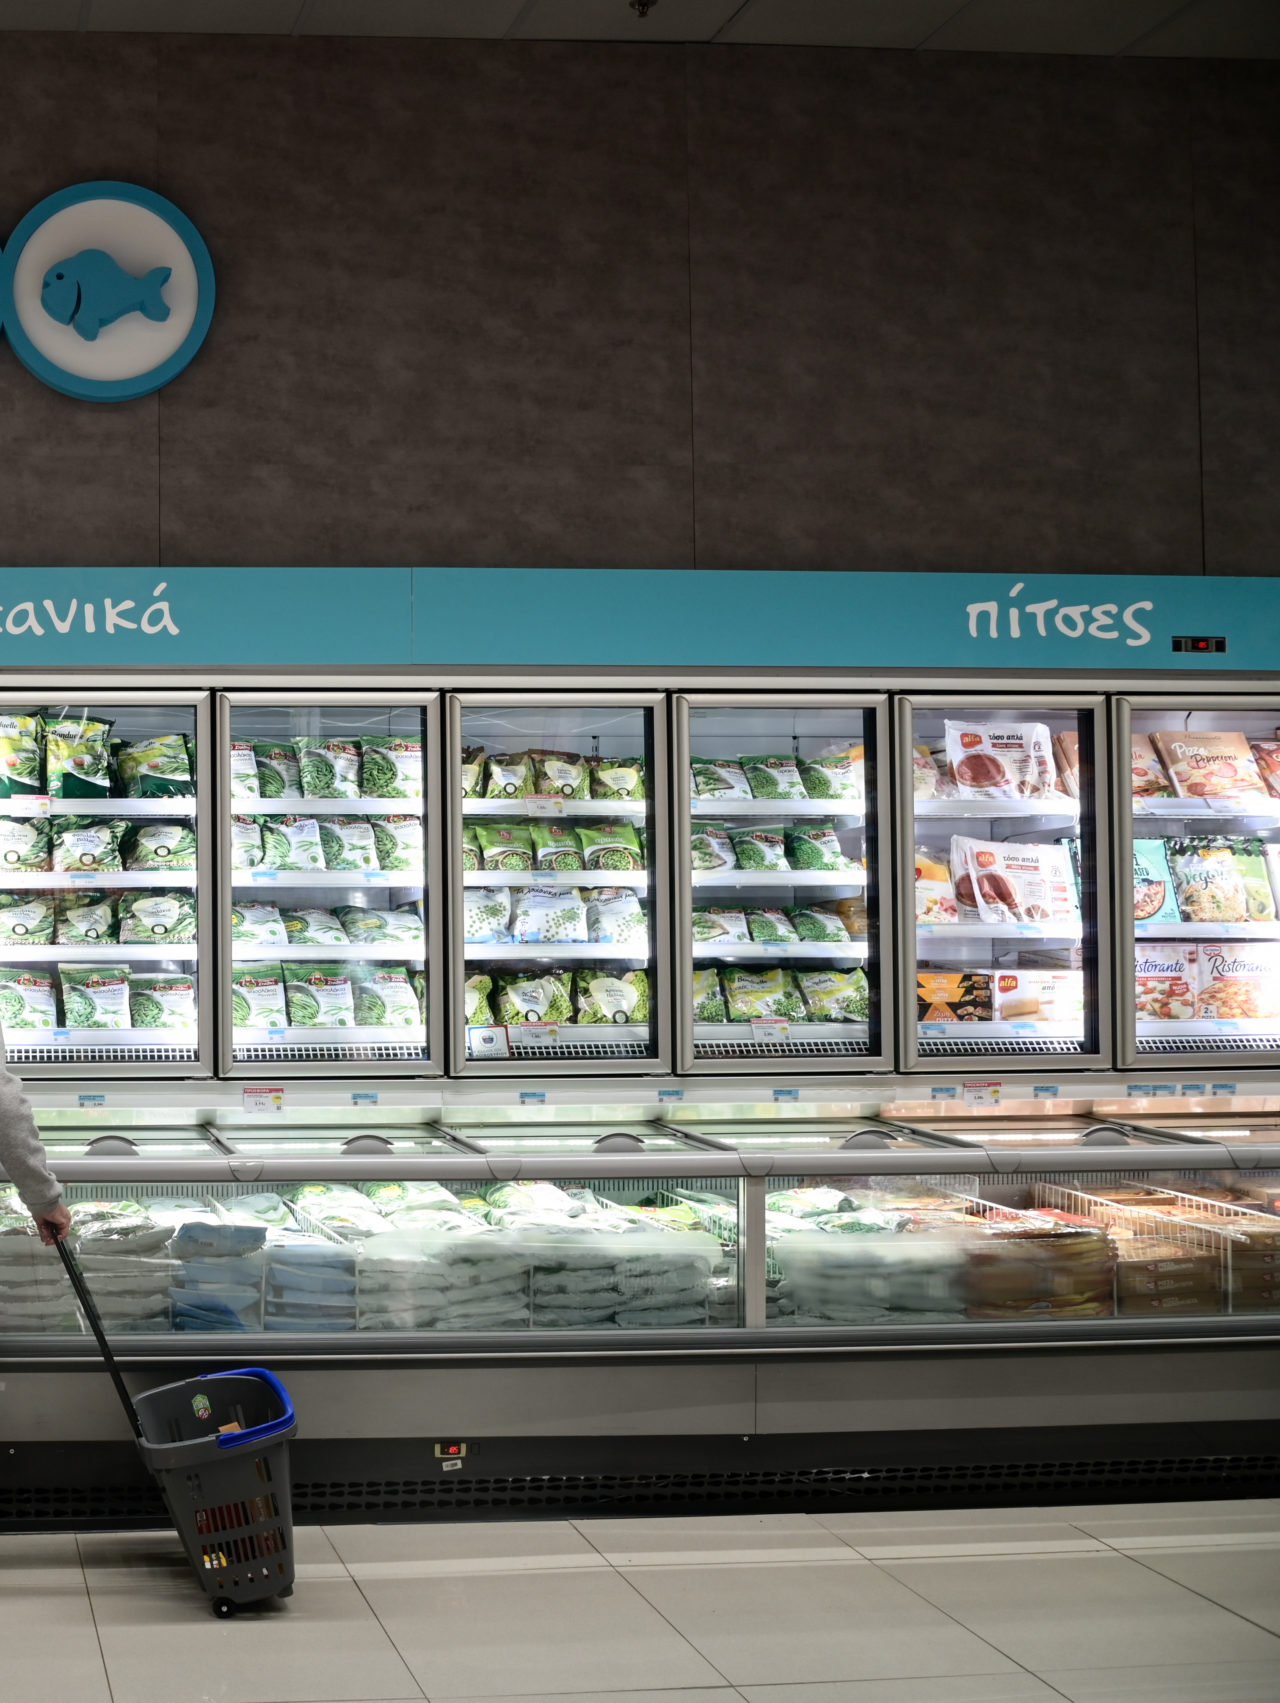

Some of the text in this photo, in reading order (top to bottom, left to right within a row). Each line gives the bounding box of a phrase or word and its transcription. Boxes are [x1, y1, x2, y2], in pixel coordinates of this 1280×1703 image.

[966, 582, 1154, 647] πίτσες
[988, 733, 1023, 741] τόσο απλά
[1171, 742, 1208, 759] Pizza
[1191, 754, 1238, 768] Pepperoni
[1021, 855, 1039, 863] απλά
[1134, 867, 1150, 877] ASED
[1135, 958, 1185, 973] istorante
[1208, 955, 1272, 977] Ristoran
[999, 978, 1016, 987] alfa
